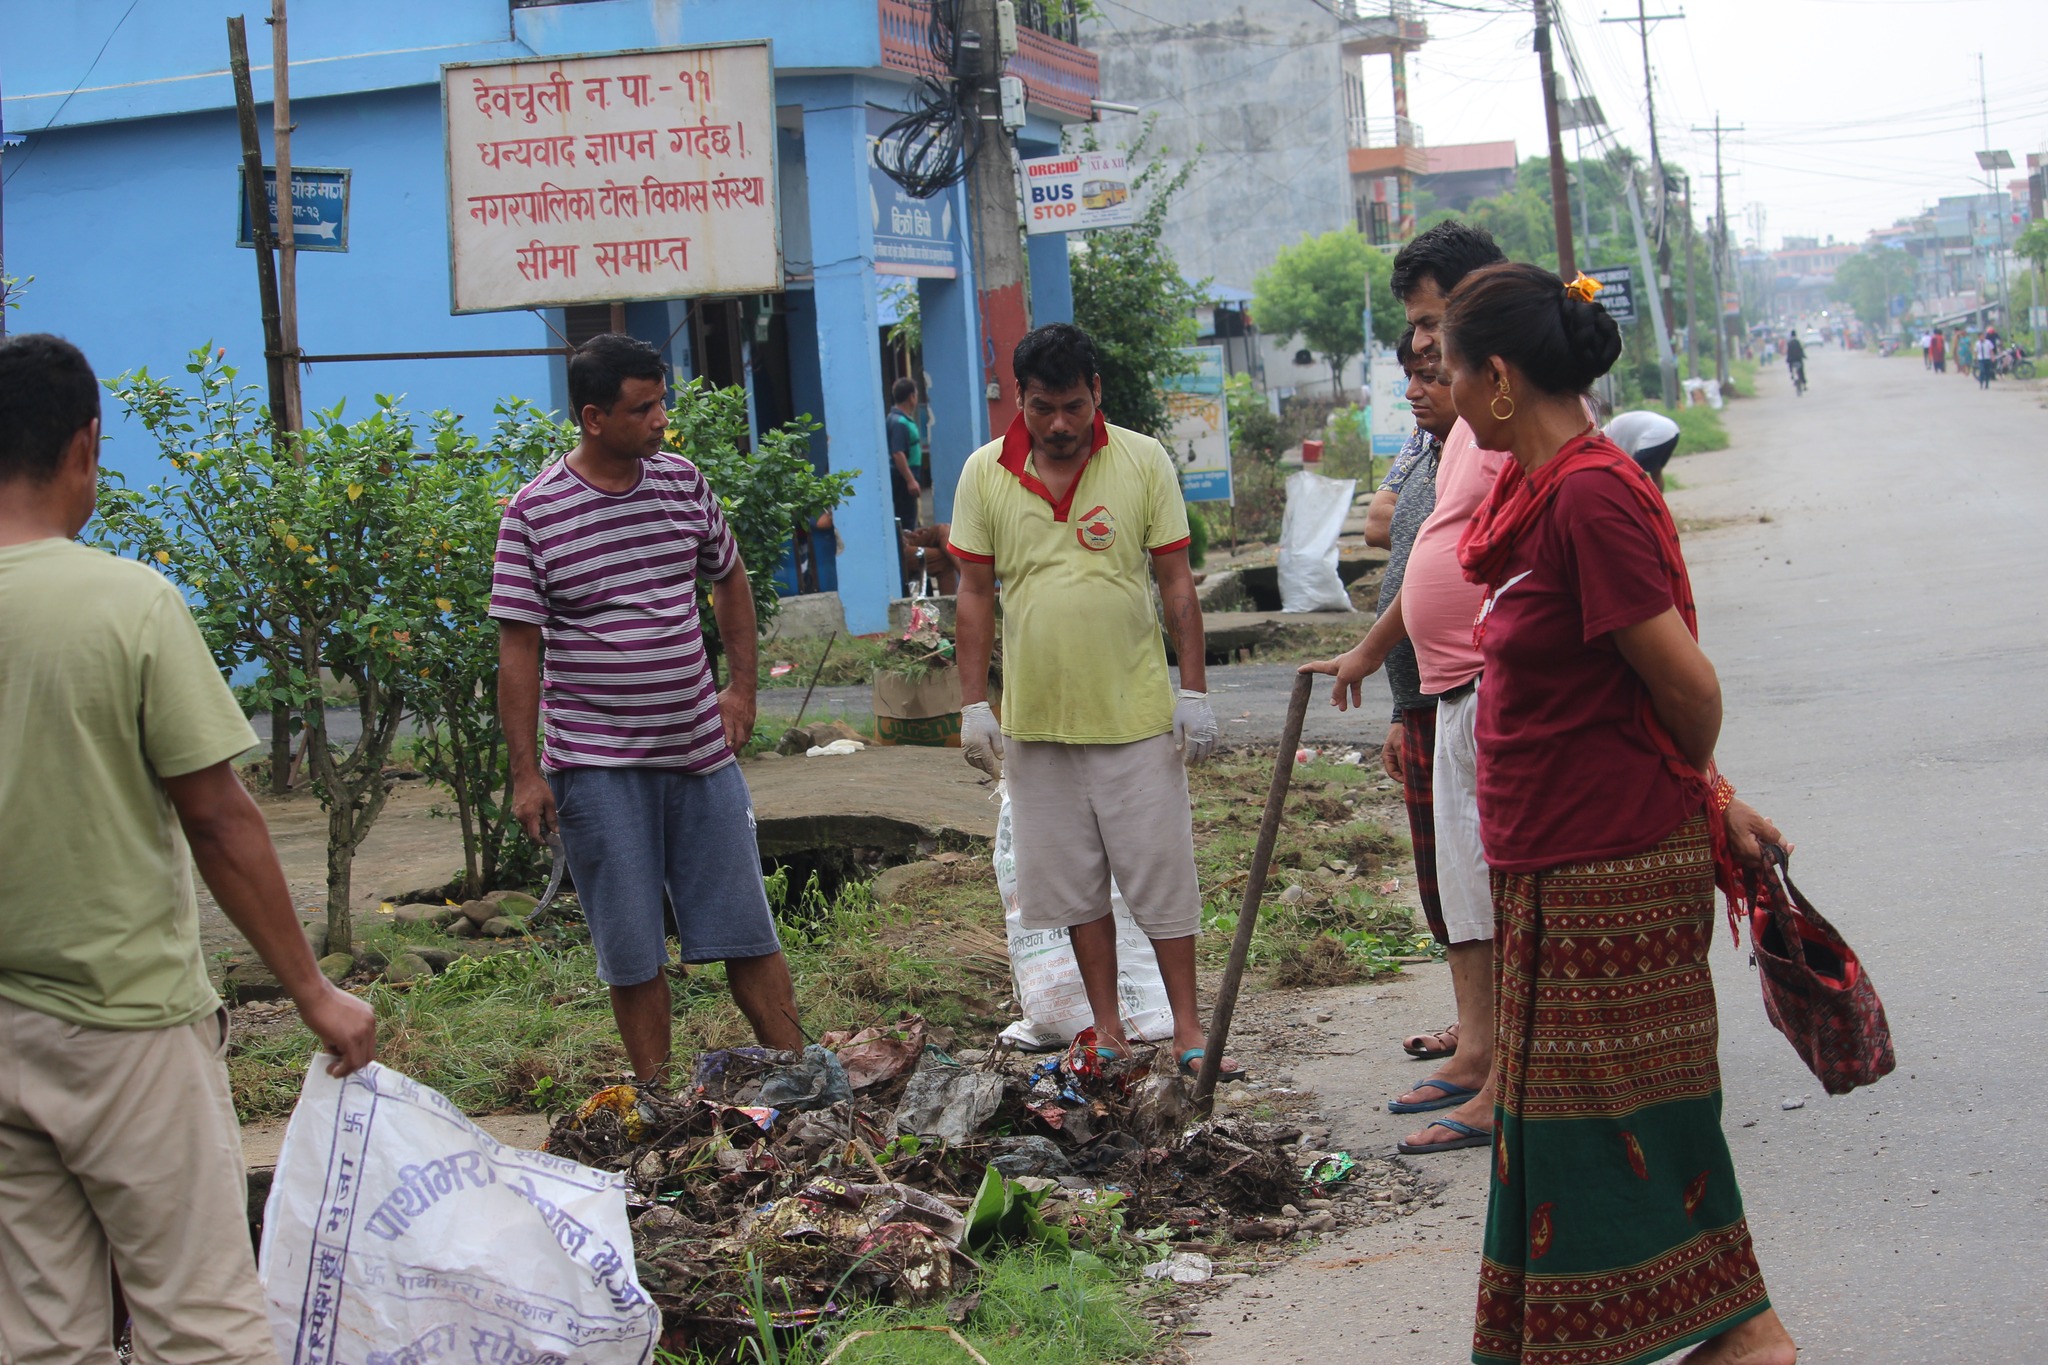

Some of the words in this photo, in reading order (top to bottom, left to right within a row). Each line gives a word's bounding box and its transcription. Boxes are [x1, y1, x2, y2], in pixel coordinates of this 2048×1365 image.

[473, 72, 574, 124] देवचुली
[477, 136, 577, 170] धन्यवाद
[584, 130, 658, 166] ज्ञापन
[1028, 160, 1078, 177] ORCHID
[318, 178, 344, 200] मार्ग
[467, 182, 596, 226] नगरपालिका
[597, 179, 638, 219] टोल
[641, 175, 709, 216] विकास
[712, 172, 764, 211] संस्था
[1031, 184, 1073, 204] BUS
[1033, 203, 1077, 221] STOP
[516, 240, 581, 282] सीमा
[593, 237, 691, 277] समाप्त
